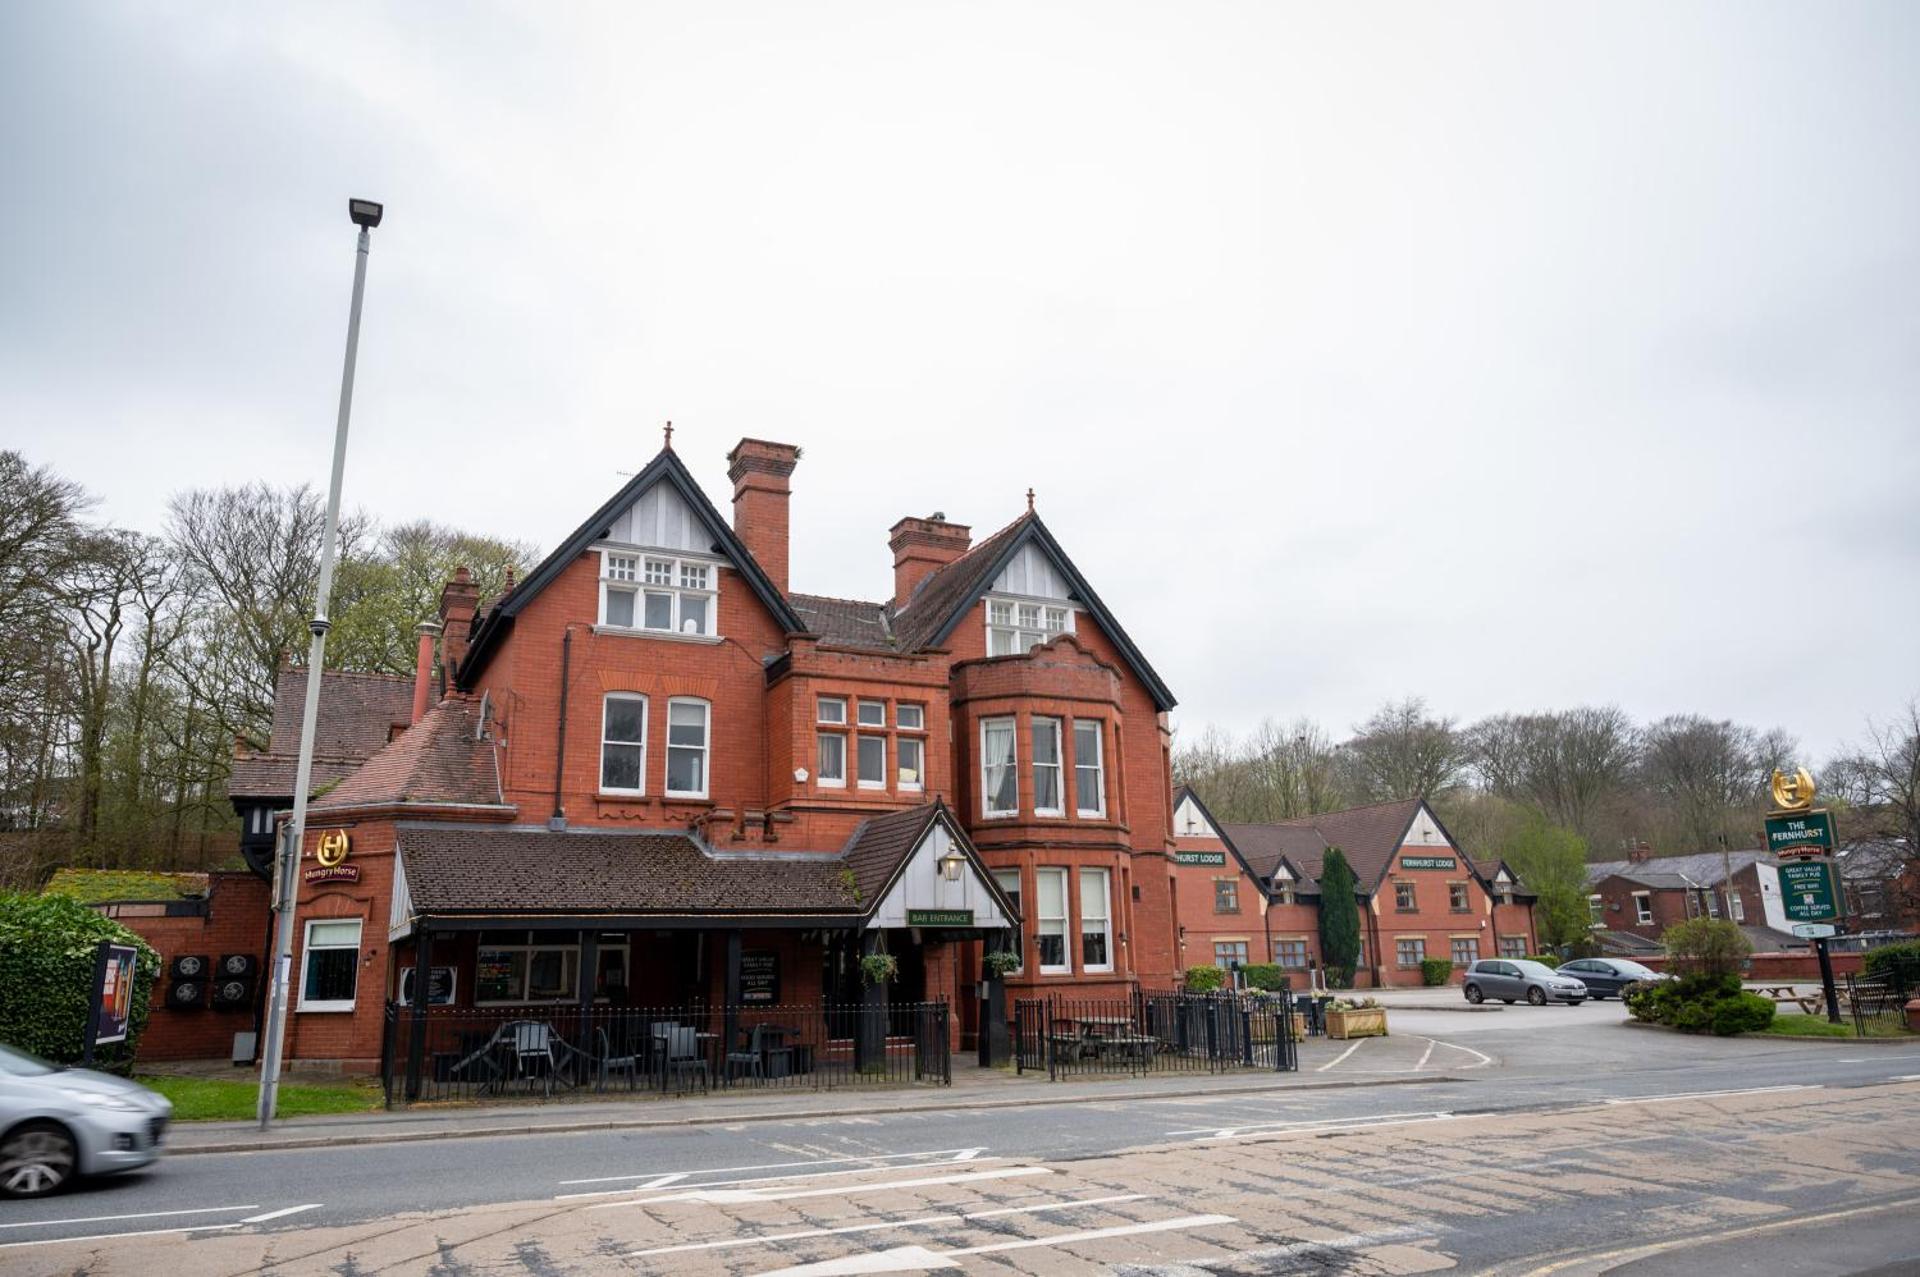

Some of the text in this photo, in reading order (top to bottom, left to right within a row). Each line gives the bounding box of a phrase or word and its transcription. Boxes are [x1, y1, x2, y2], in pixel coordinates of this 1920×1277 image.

[1787, 821, 1806, 831] THE
[1772, 828, 1824, 840] FERNHURST
[1175, 854, 1223, 863] HURST LODGE
[1402, 859, 1454, 867] FERNHURST LODGE
[305, 866, 357, 879] Hungry Horse
[912, 914, 968, 922] BAR ENTRANCE
